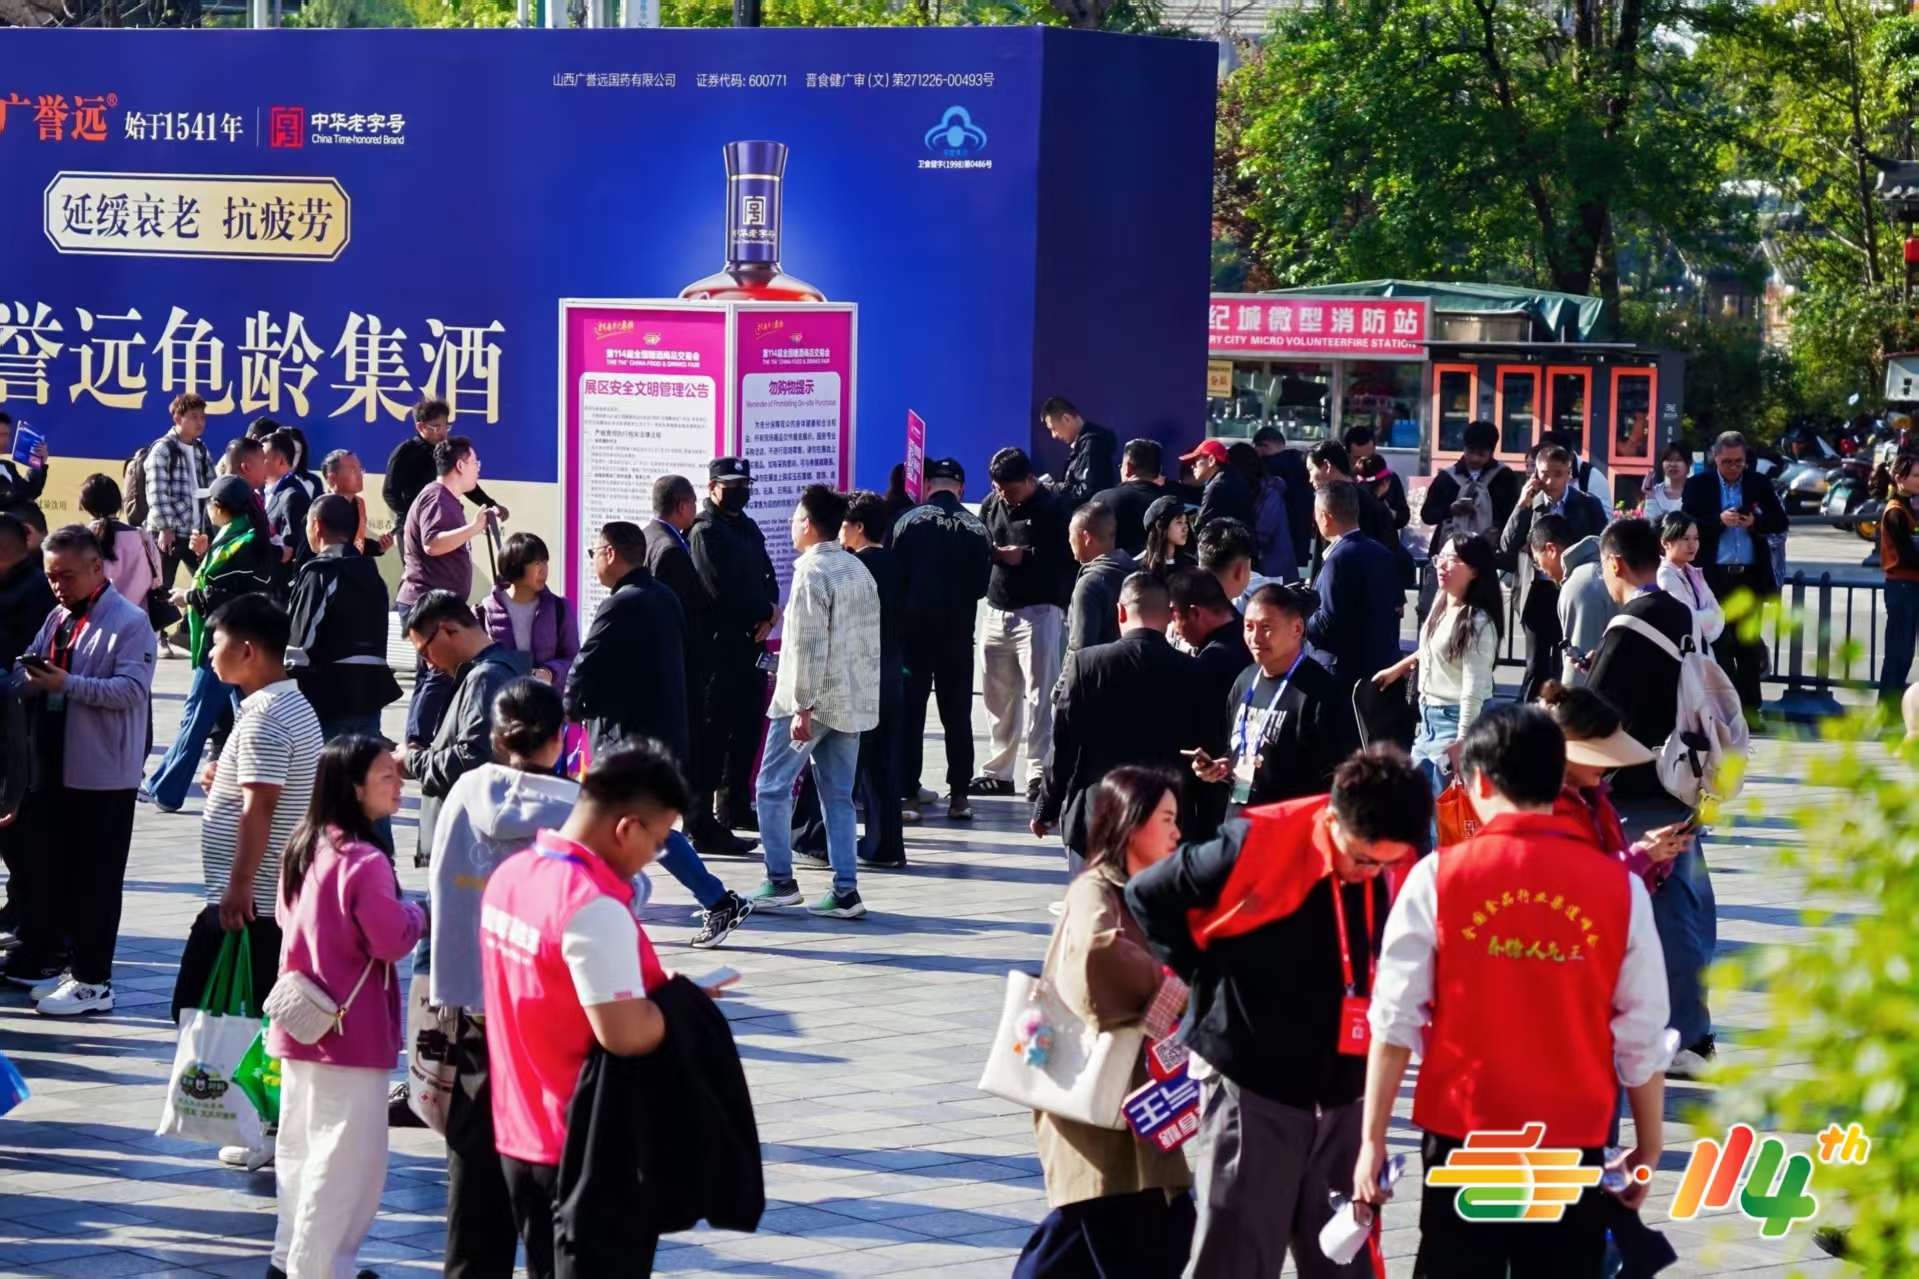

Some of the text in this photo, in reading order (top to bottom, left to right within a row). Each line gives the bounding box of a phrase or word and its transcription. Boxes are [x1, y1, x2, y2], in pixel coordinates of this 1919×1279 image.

[553, 73, 676, 87] 山西广誉远国药有限公司
[749, 74, 787, 86] 600771
[124, 111, 244, 142] 始于1541年
[311, 113, 406, 133] 中华老字号
[312, 133, 405, 145] China Time-honored Brand
[61, 193, 333, 242] 延缓衰老 抗疲劳
[1208, 305, 1418, 335] 纪城微型消防站
[1224, 335, 1247, 344] CITY
[1250, 336, 1284, 345] MICRO
[584, 380, 709, 398] 展区安全文明管理公告
[768, 379, 815, 395] 勿购物提示
